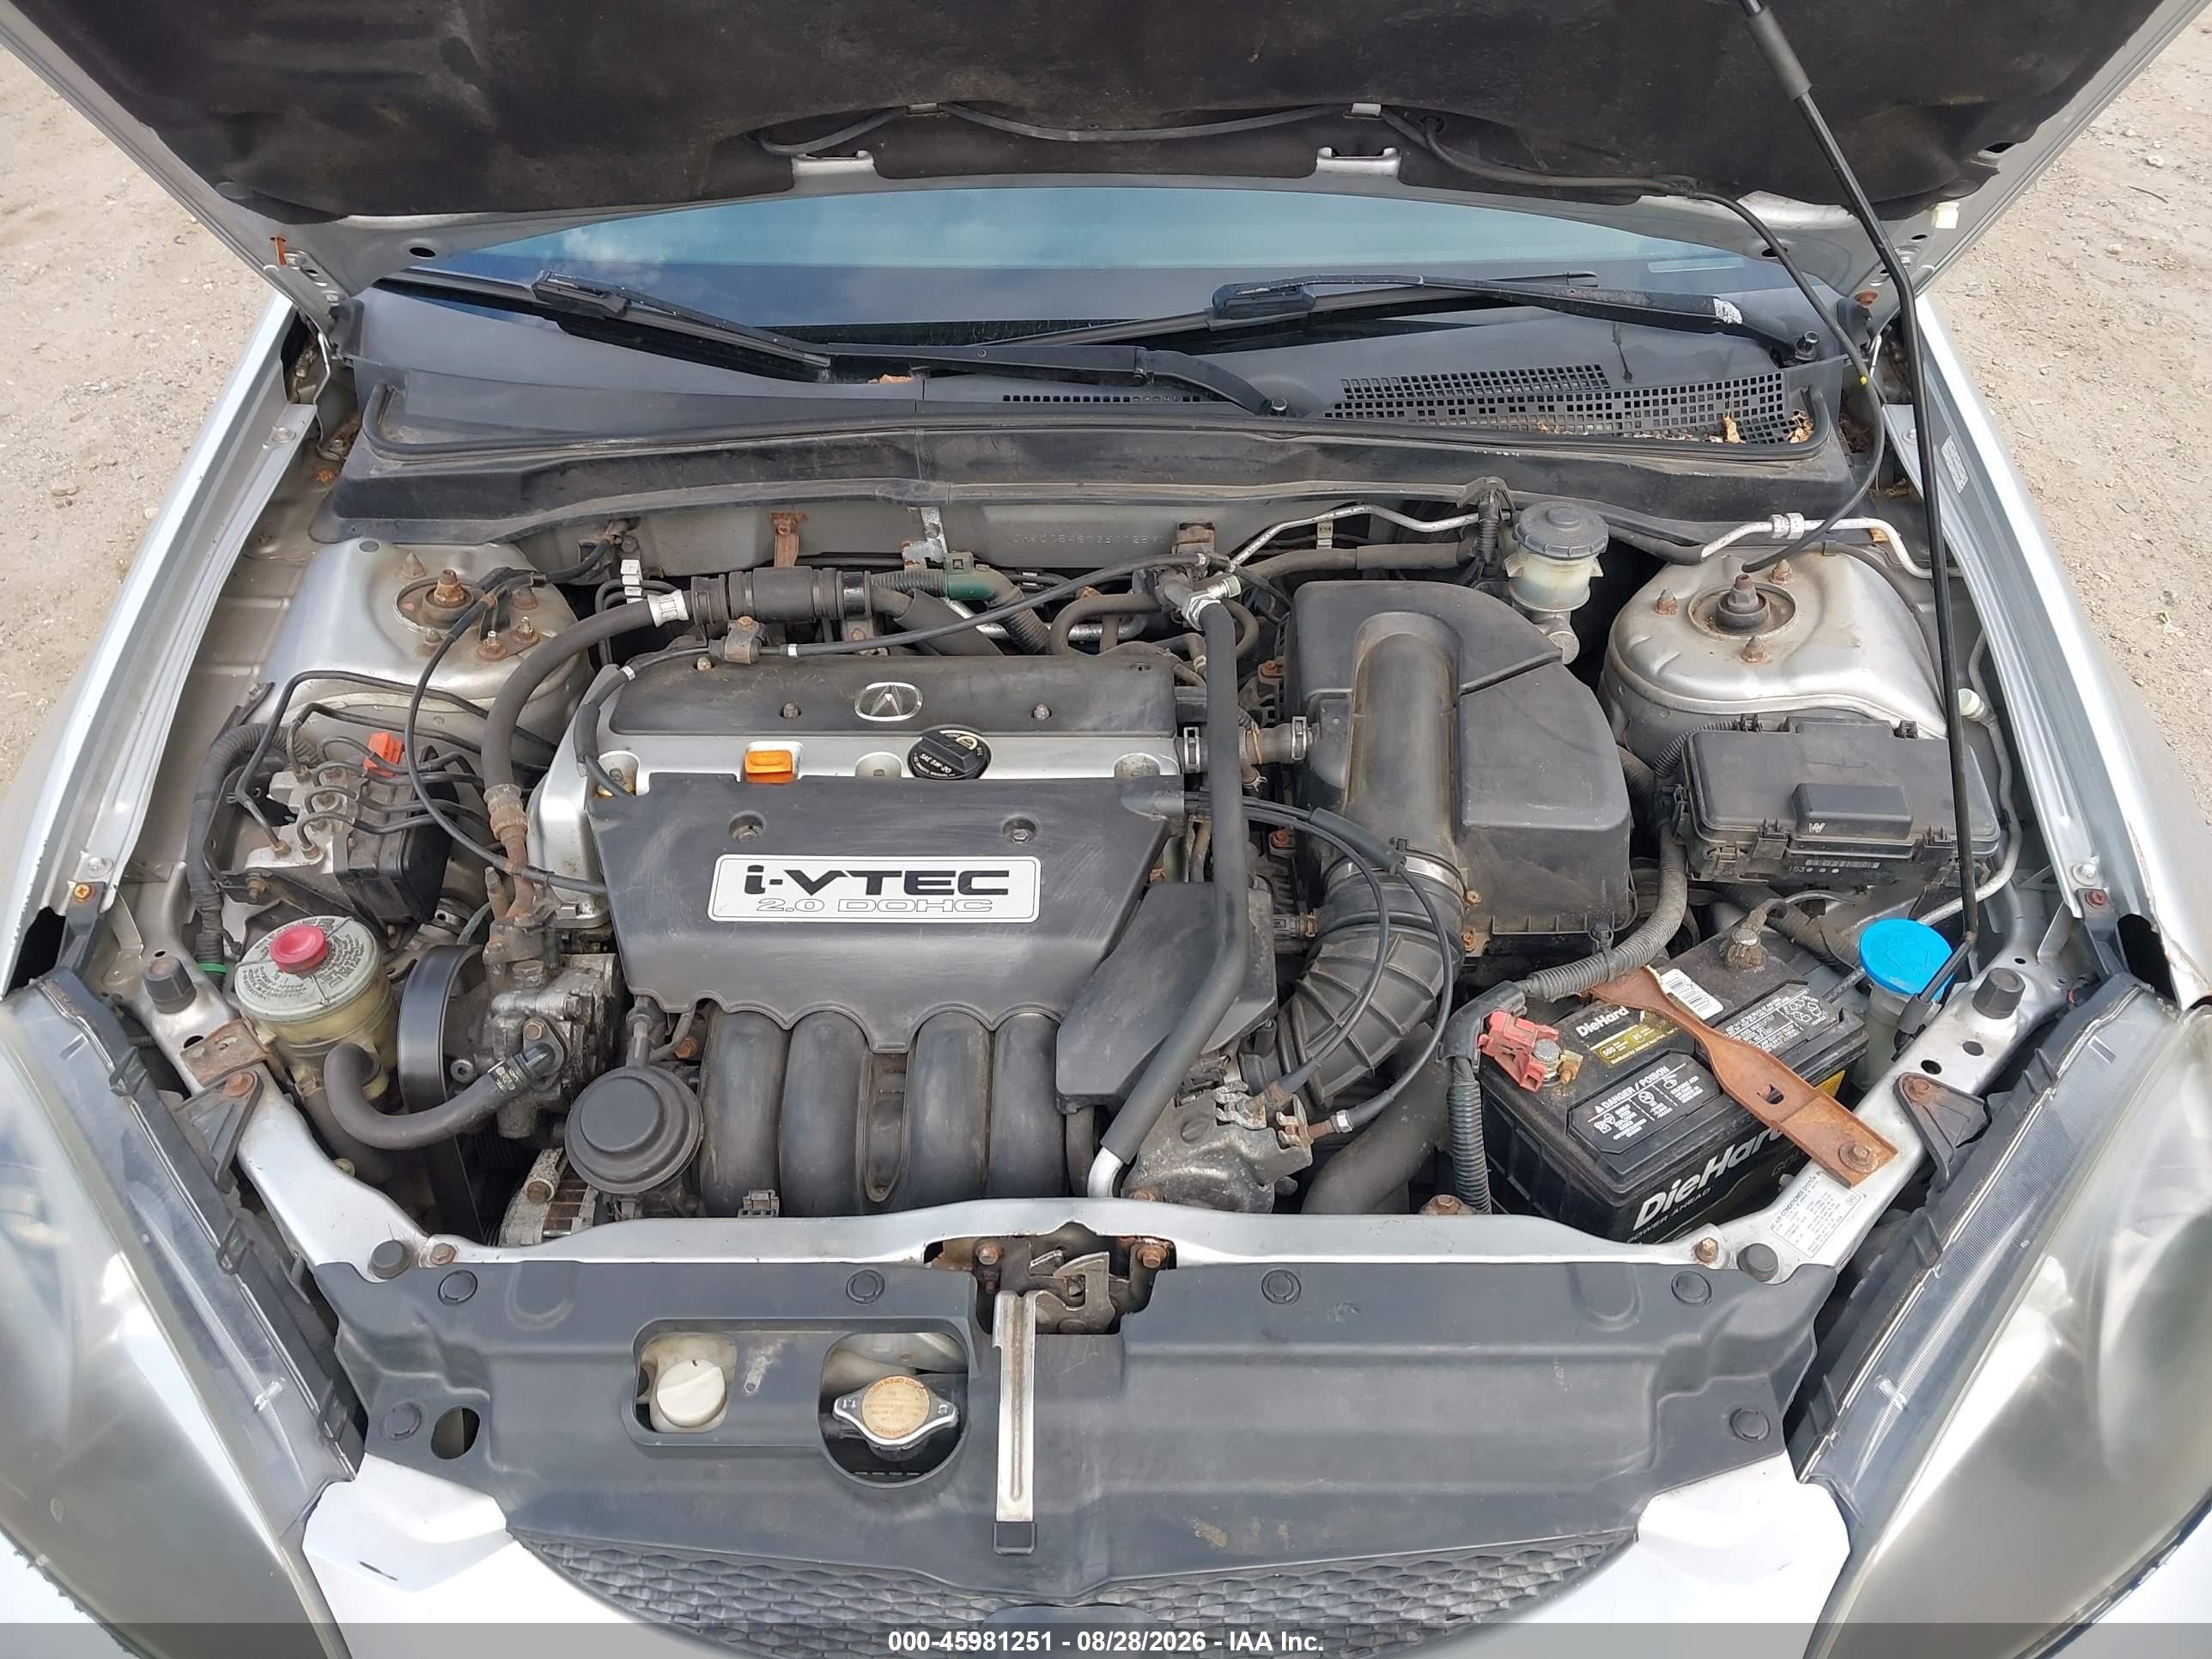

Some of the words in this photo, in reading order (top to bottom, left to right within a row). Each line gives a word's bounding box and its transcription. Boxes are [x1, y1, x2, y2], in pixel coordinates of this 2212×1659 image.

[744, 865, 1009, 896] i-VTEC
[757, 898, 824, 912] 2.0
[838, 899, 992, 913] DOHC
[1575, 1006, 1630, 1037] DieHard
[1601, 1087, 1636, 1109] DANGER
[1640, 1066, 1670, 1087] POISON
[1627, 1215, 1668, 1243] POWER
[1669, 1188, 1711, 1218] AHEAD
